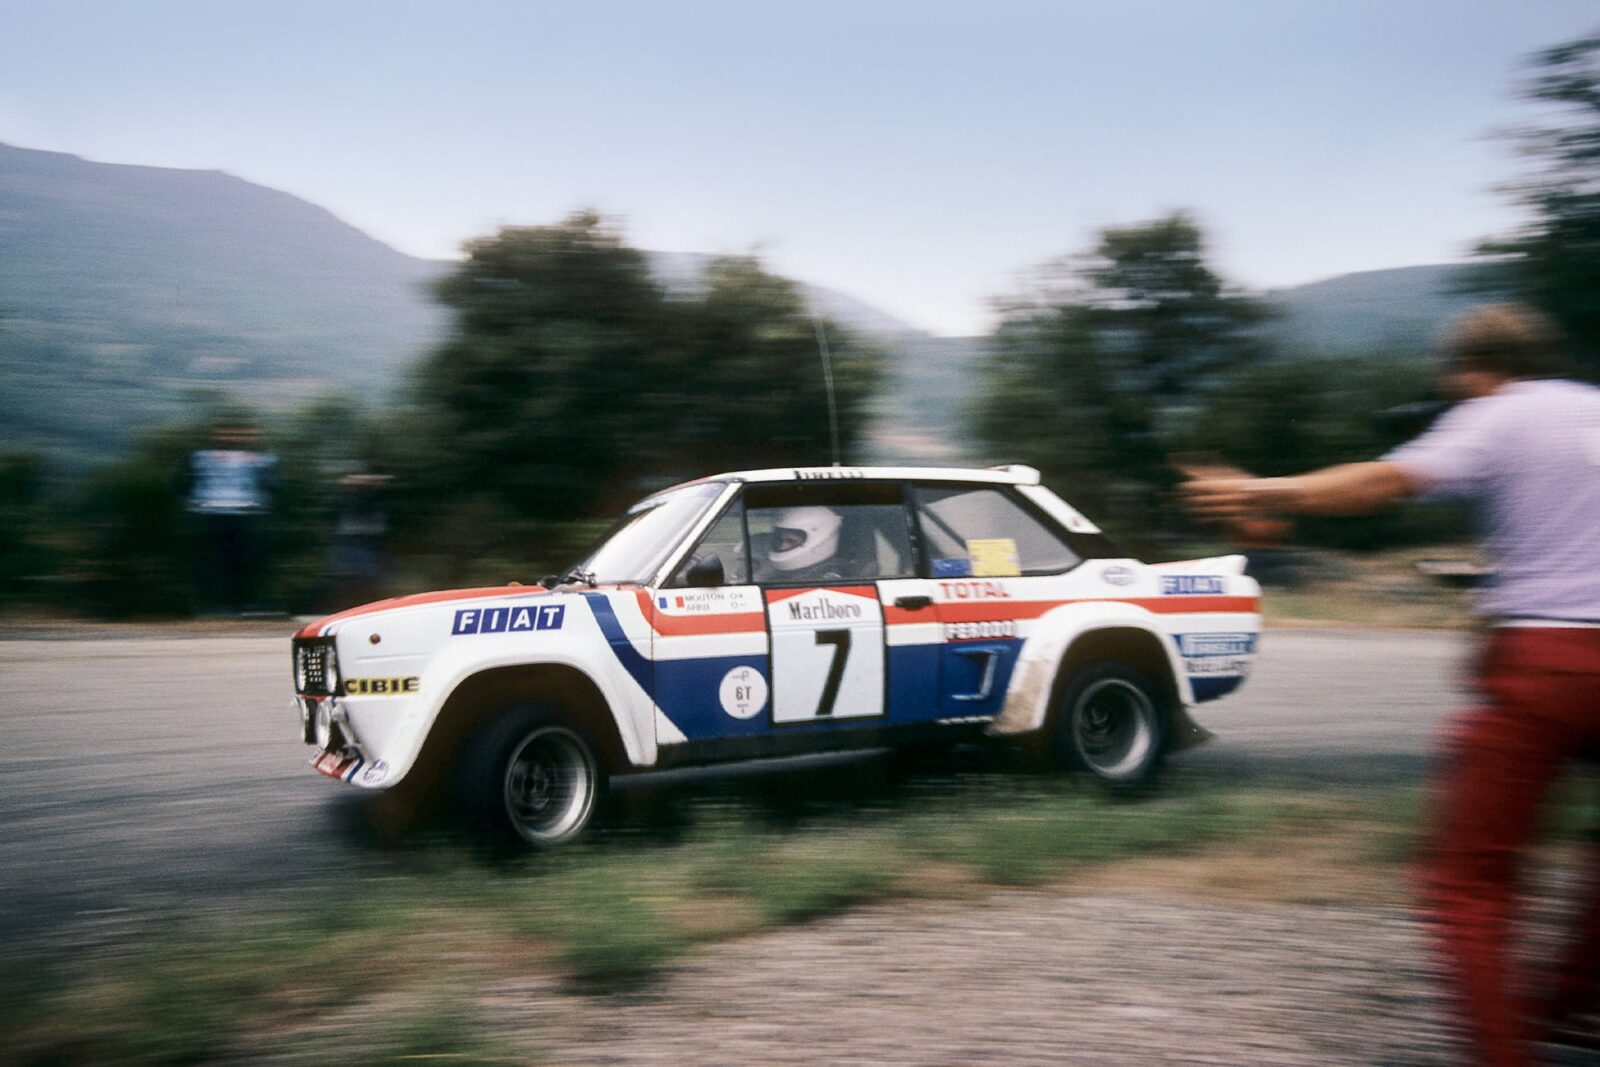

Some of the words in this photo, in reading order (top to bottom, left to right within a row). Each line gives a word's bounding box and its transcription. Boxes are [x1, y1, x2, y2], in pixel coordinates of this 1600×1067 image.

[685, 592, 725, 601] MOUTON
[938, 582, 1010, 599] TOTAL
[455, 606, 562, 633] FIAT
[788, 598, 862, 621] Marlboro
[815, 628, 852, 716] 7
